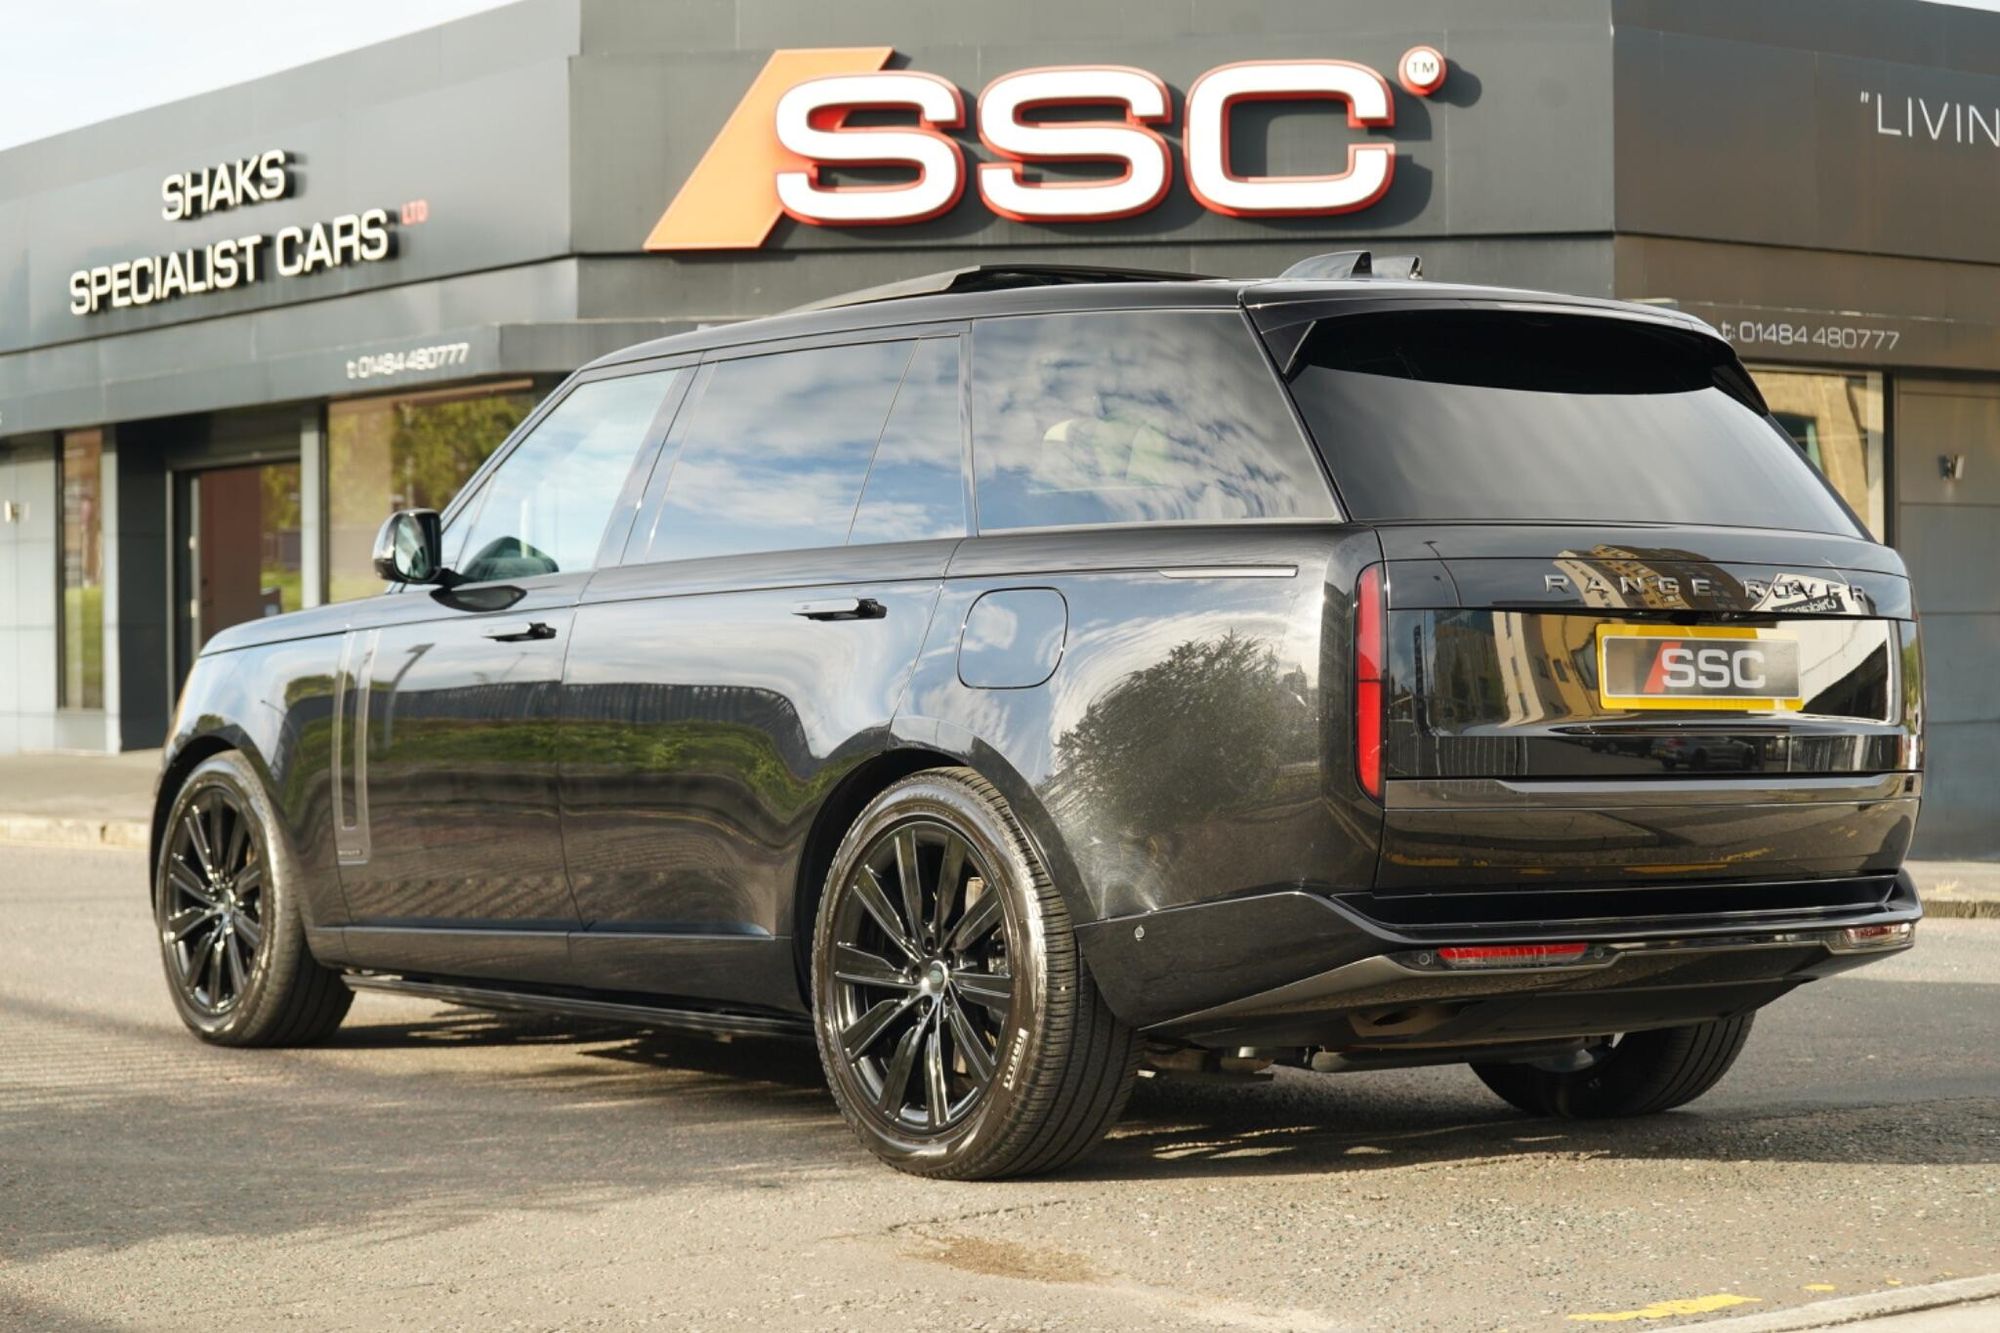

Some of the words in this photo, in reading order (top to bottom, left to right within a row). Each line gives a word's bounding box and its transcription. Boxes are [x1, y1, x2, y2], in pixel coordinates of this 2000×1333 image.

[1411, 61, 1435, 74] TM
[773, 58, 1396, 227] SSC
[161, 149, 287, 221] SHAKS
[69, 234, 262, 316] SPECIALIST
[276, 208, 389, 276] CARS
[401, 199, 429, 226] LTD
[1739, 321, 1808, 345] 01484
[1812, 327, 1900, 350] 480777
[1544, 574, 1712, 598] RANGE
[1743, 578, 1867, 602] ROVER
[1661, 648, 1766, 689] SSC
